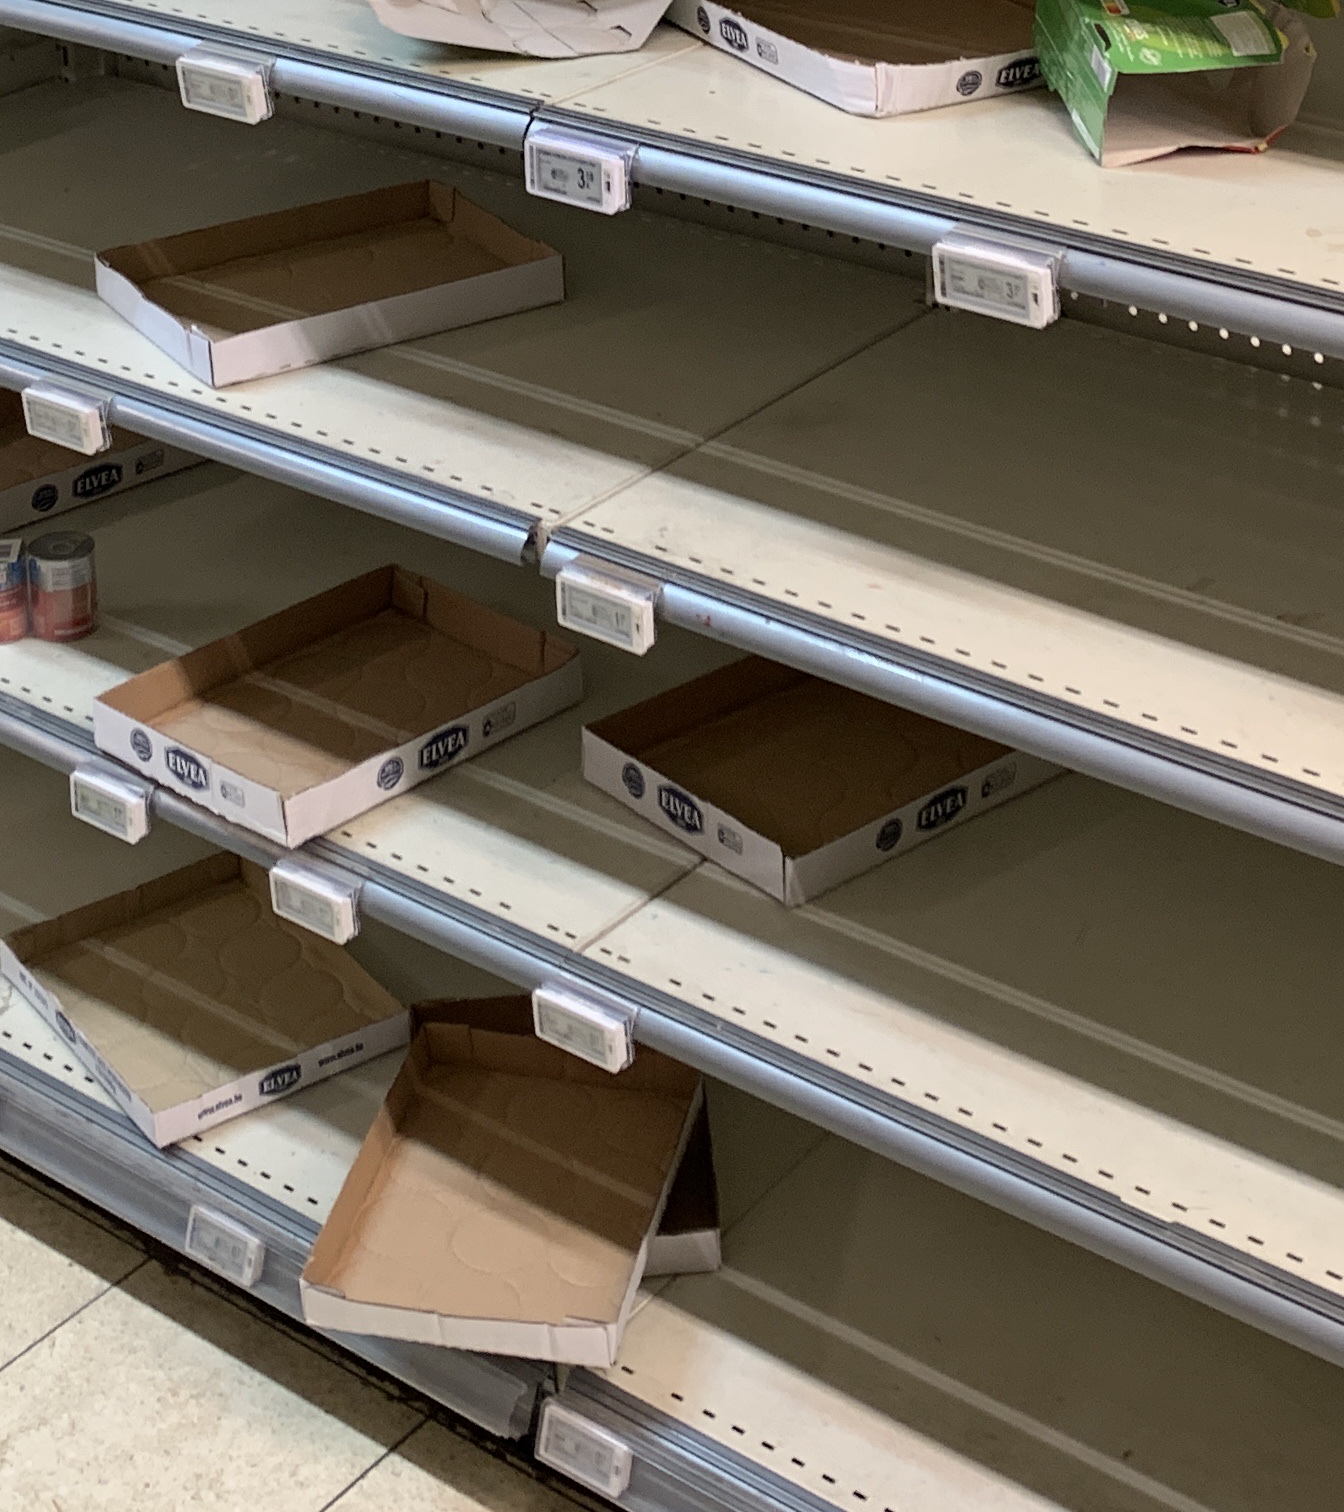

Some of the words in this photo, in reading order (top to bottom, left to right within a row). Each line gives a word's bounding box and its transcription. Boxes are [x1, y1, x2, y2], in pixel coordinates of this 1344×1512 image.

[720, 22, 747, 47] ELVEA
[76, 468, 120, 494] ELVEA
[421, 731, 467, 767] ELVEA
[167, 751, 207, 788] ELVEA
[660, 791, 702, 830] ELVEA
[920, 792, 966, 829] ELVEA
